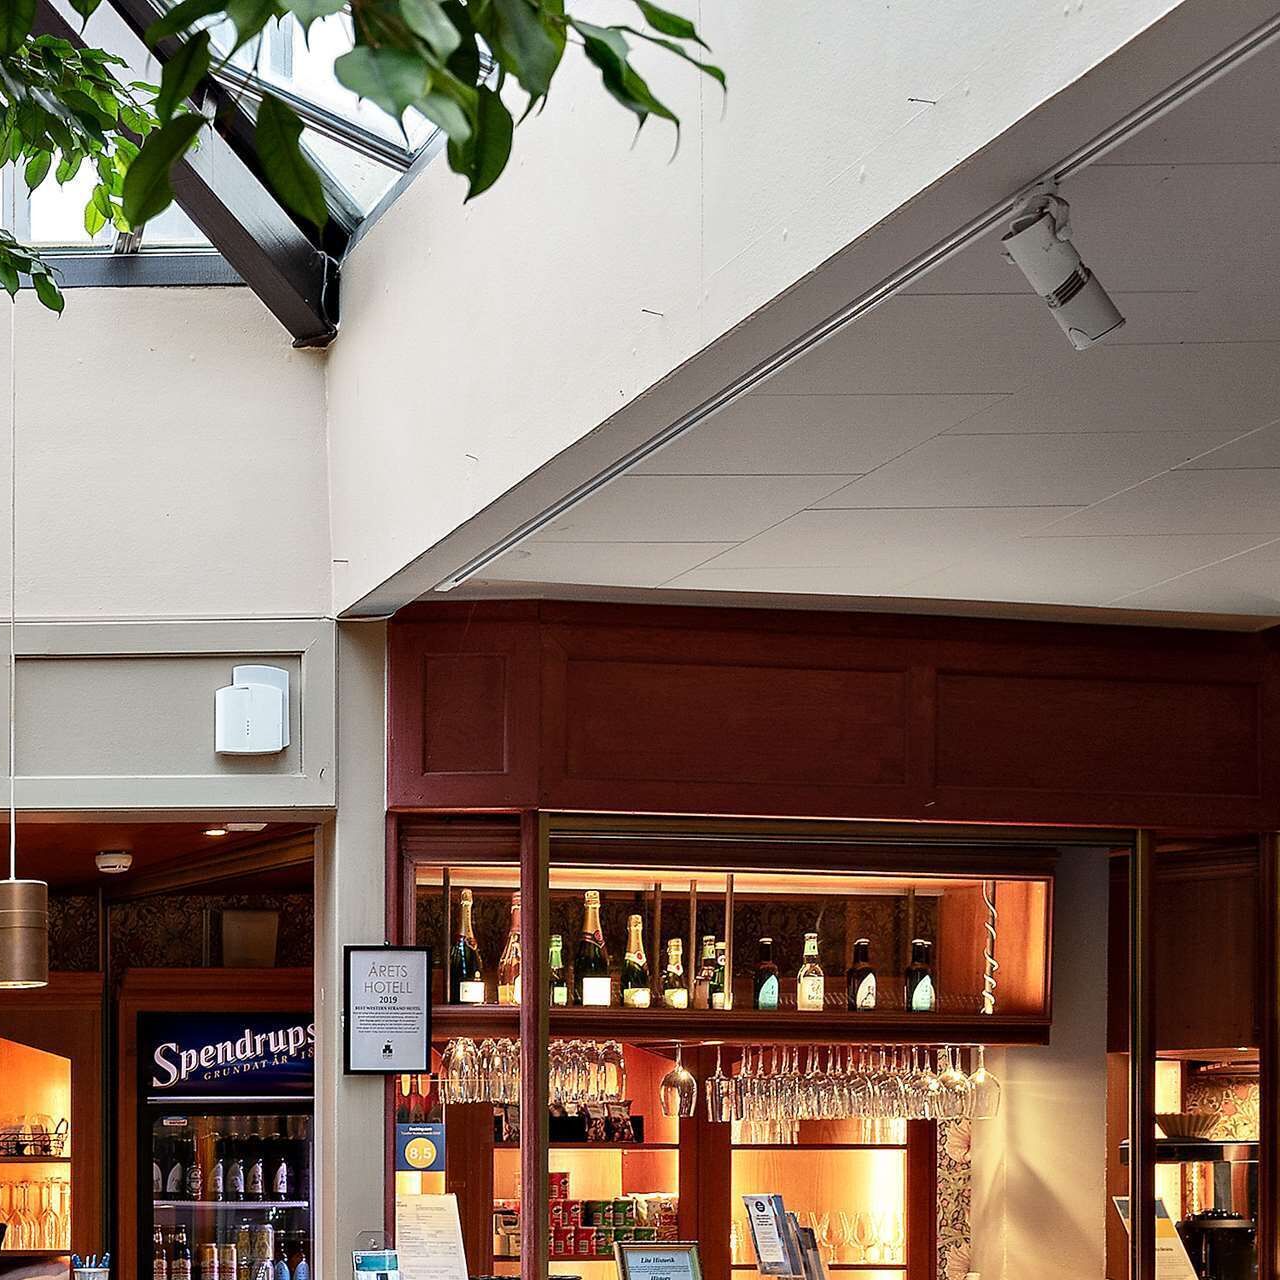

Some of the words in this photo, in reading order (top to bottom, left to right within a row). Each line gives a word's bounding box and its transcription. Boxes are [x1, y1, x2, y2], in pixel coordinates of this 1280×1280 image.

[368, 962, 408, 977] ÅRETS
[364, 982, 413, 994] HOTELL
[379, 996, 398, 1004] 2019
[152, 1023, 315, 1088] Spendrups
[204, 1060, 267, 1080] GRUNDAT
[272, 1055, 288, 1066] ÅR
[410, 1148, 432, 1160] 8,5
